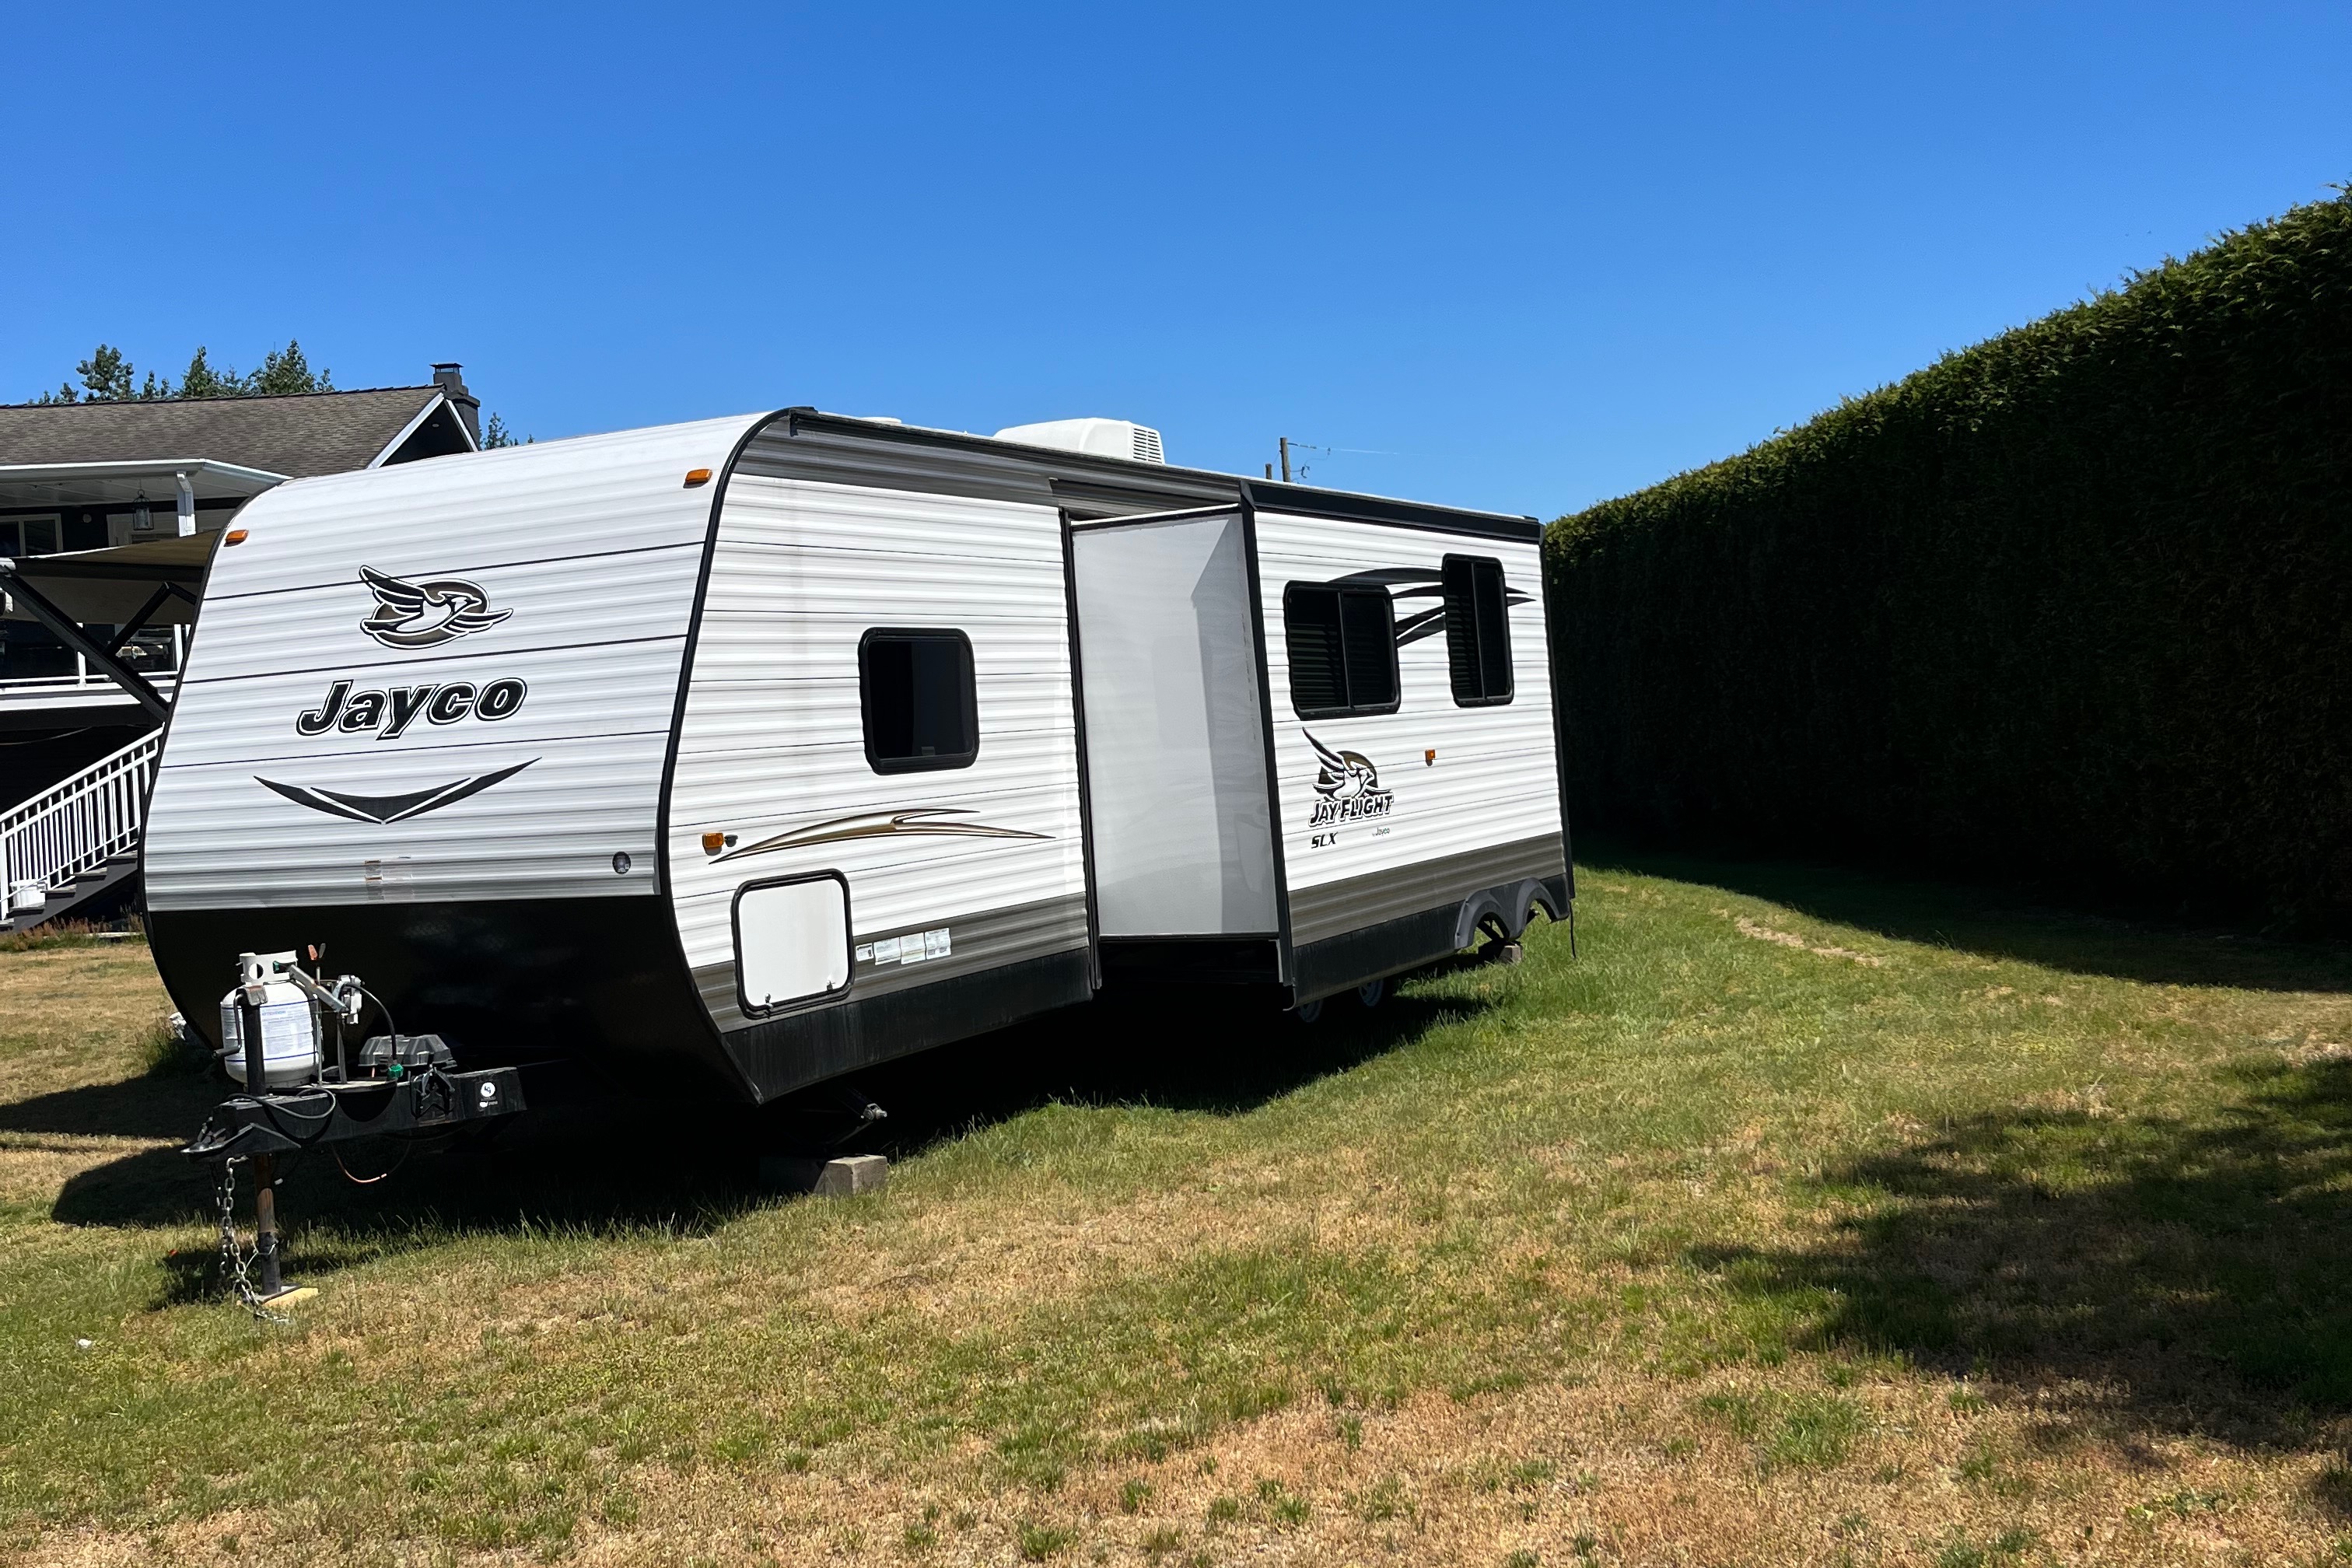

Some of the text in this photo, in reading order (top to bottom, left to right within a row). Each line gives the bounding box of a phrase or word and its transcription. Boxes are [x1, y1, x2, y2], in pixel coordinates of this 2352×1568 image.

[296, 677, 528, 740] Jayco
[1308, 792, 1395, 828] JAY FLIGHT
[1311, 831, 1338, 849] SLX
